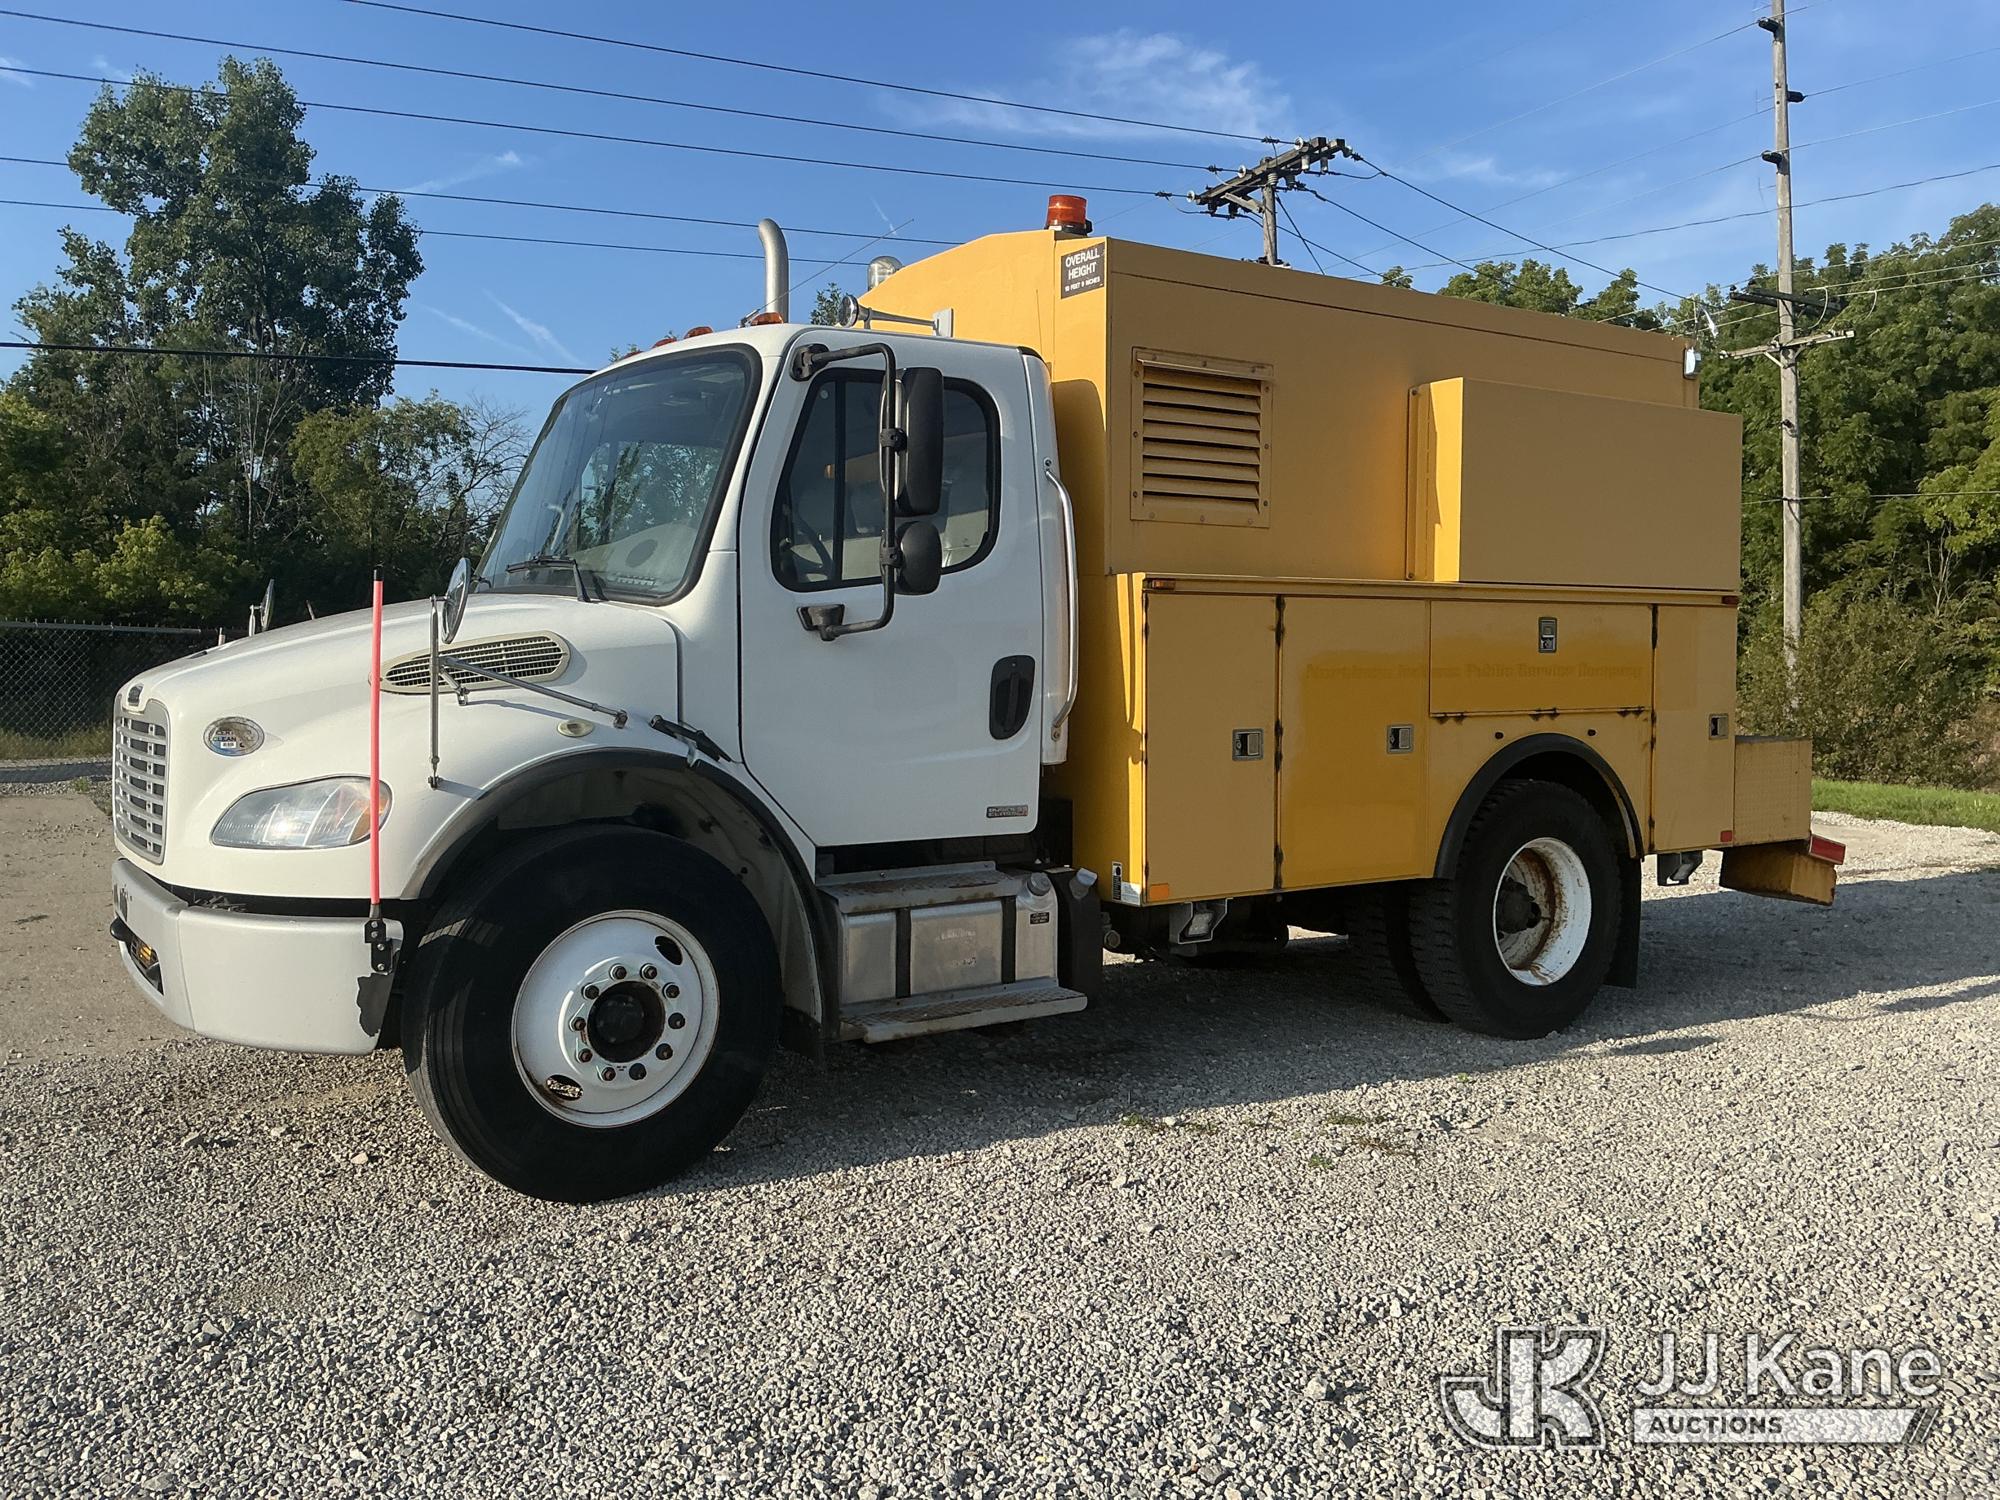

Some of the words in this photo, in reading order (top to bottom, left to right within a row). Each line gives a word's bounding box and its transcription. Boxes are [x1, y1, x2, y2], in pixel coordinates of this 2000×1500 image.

[1065, 248, 1100, 268] OVERALL
[1068, 262, 1097, 280] HEIGHT
[1465, 662, 1514, 678] Public
[1516, 662, 1575, 678] Service
[1577, 661, 1643, 679] Company
